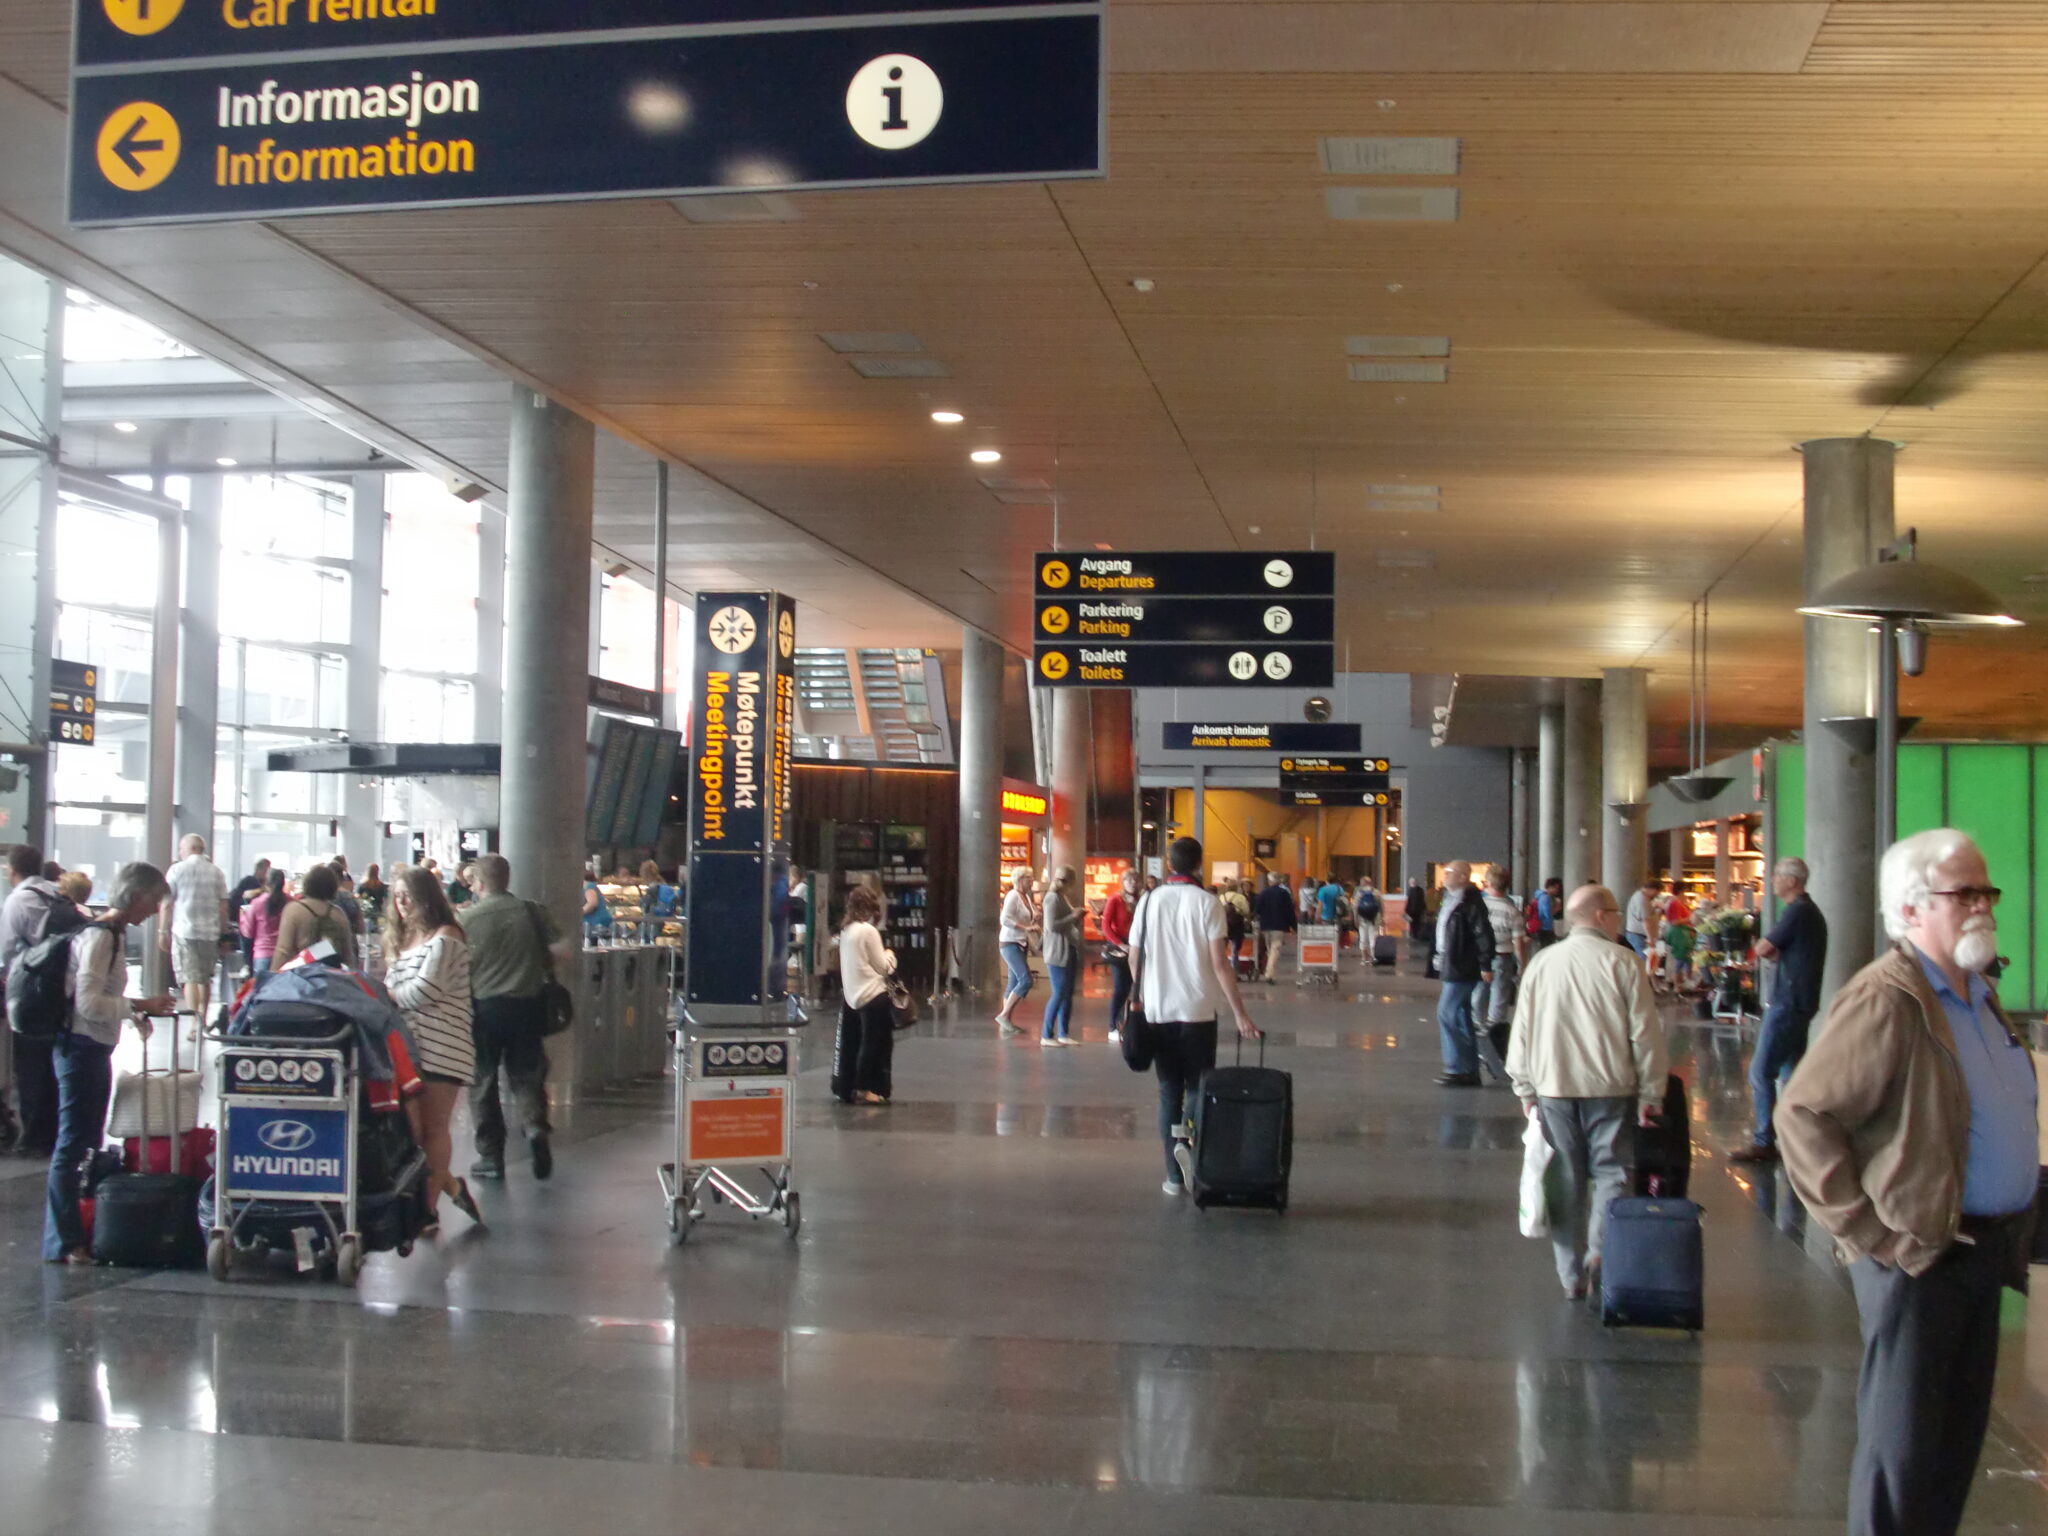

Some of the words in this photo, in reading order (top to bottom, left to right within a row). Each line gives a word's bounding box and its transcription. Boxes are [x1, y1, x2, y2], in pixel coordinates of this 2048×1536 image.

[217, 72, 480, 128] Informasjon
[215, 131, 475, 188] Information
[1080, 557, 1132, 575] Avgang
[1080, 574, 1155, 591] Departures
[1079, 603, 1144, 620] Parkering
[1079, 620, 1131, 637] Parking
[1079, 648, 1127, 663] Toalett
[1079, 665, 1124, 680] Toilets
[1191, 725, 1233, 736] Ankomst
[1234, 725, 1270, 736] innland
[731, 672, 761, 809] Møtepunkt
[783, 676, 794, 811] Møtepunkt
[1191, 736, 1228, 747] Arrivals
[1229, 736, 1272, 747] domestic
[699, 672, 730, 840] Meetingpoint
[773, 673, 785, 841] Meetingpoint
[233, 1154, 341, 1177] HYUNDAI
